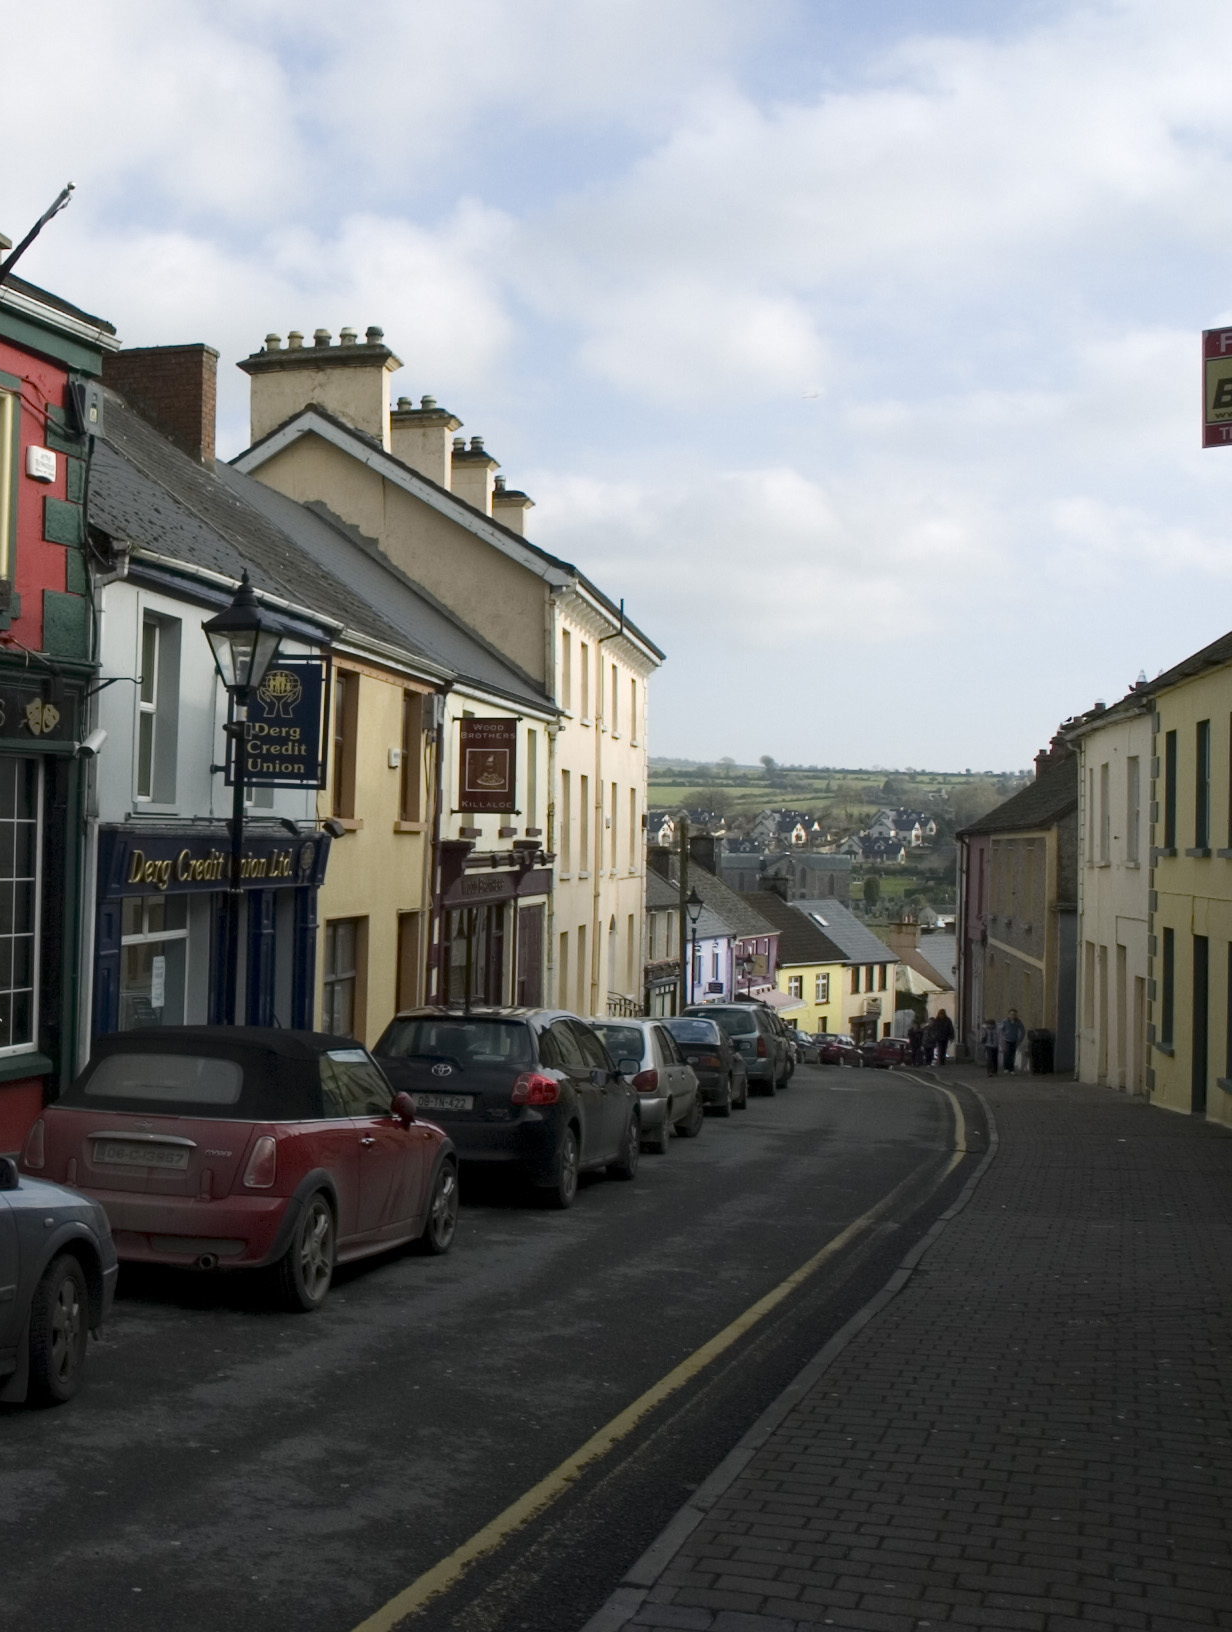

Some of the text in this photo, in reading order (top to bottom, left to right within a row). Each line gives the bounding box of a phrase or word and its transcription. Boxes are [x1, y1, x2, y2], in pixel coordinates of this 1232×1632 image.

[254, 722, 301, 740] Derg
[472, 723, 505, 732] WOOD
[460, 732, 516, 740] BROTHERS
[246, 740, 308, 756] Credit
[247, 758, 306, 774] Union
[461, 800, 513, 809] KILLALOE
[128, 849, 172, 891] Derg
[177, 848, 225, 882] Credit
